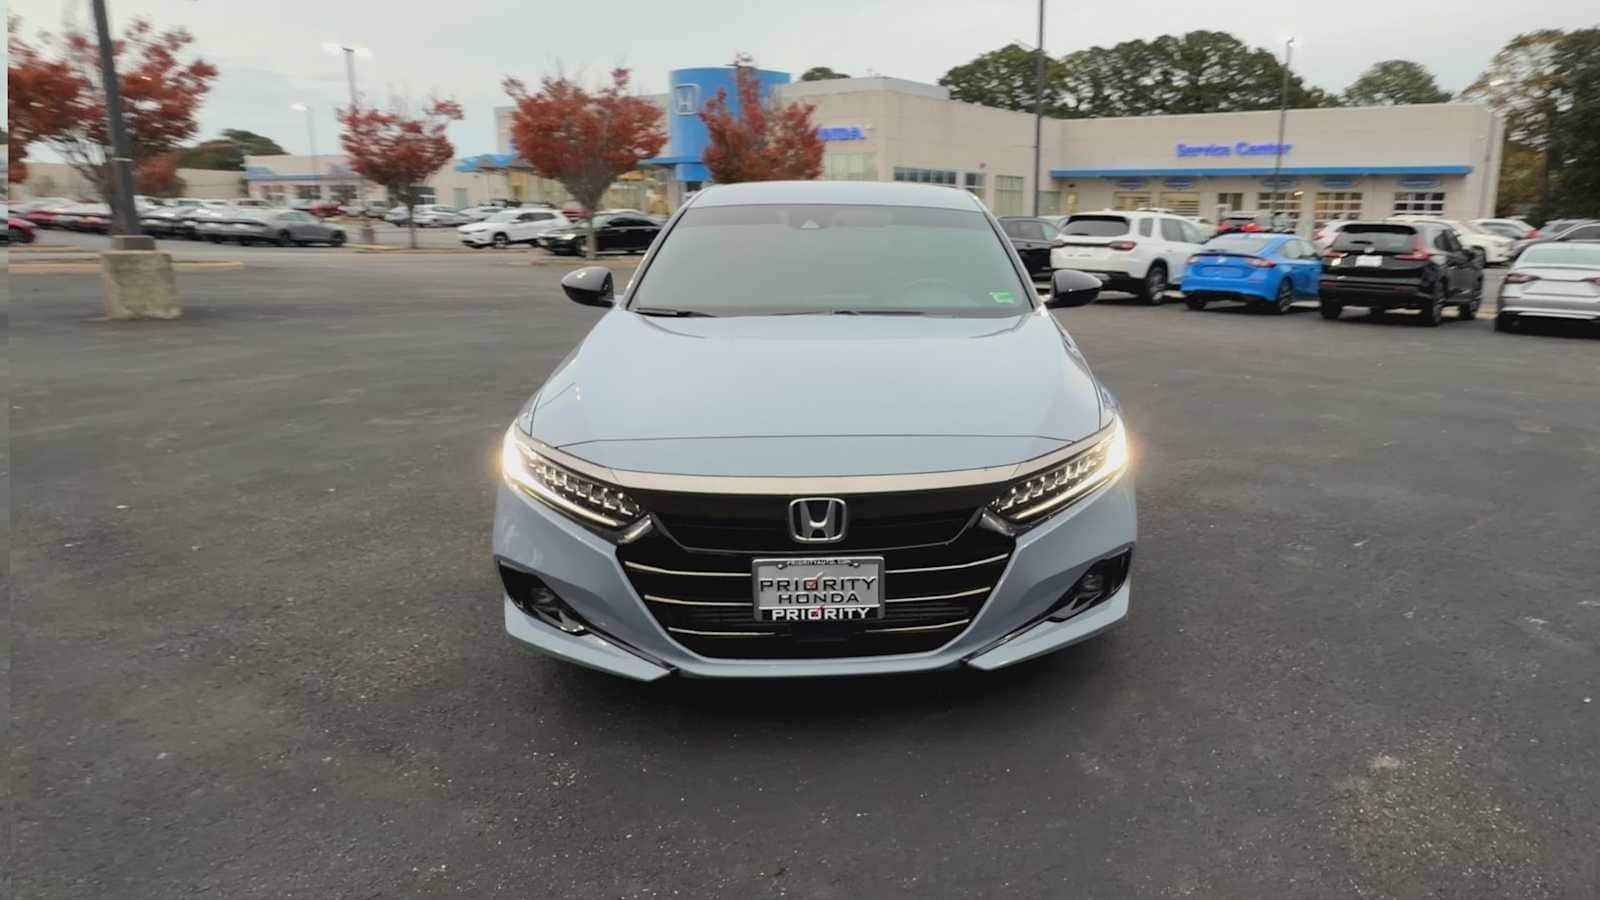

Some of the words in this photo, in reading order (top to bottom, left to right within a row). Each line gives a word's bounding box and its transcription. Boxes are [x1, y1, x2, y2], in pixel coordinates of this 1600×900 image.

[1176, 143, 1231, 157] Service
[1235, 142, 1293, 155] Center
[759, 576, 876, 592] PRIORITY
[777, 591, 860, 604] HONDA
[771, 607, 870, 621] PRIORITY
